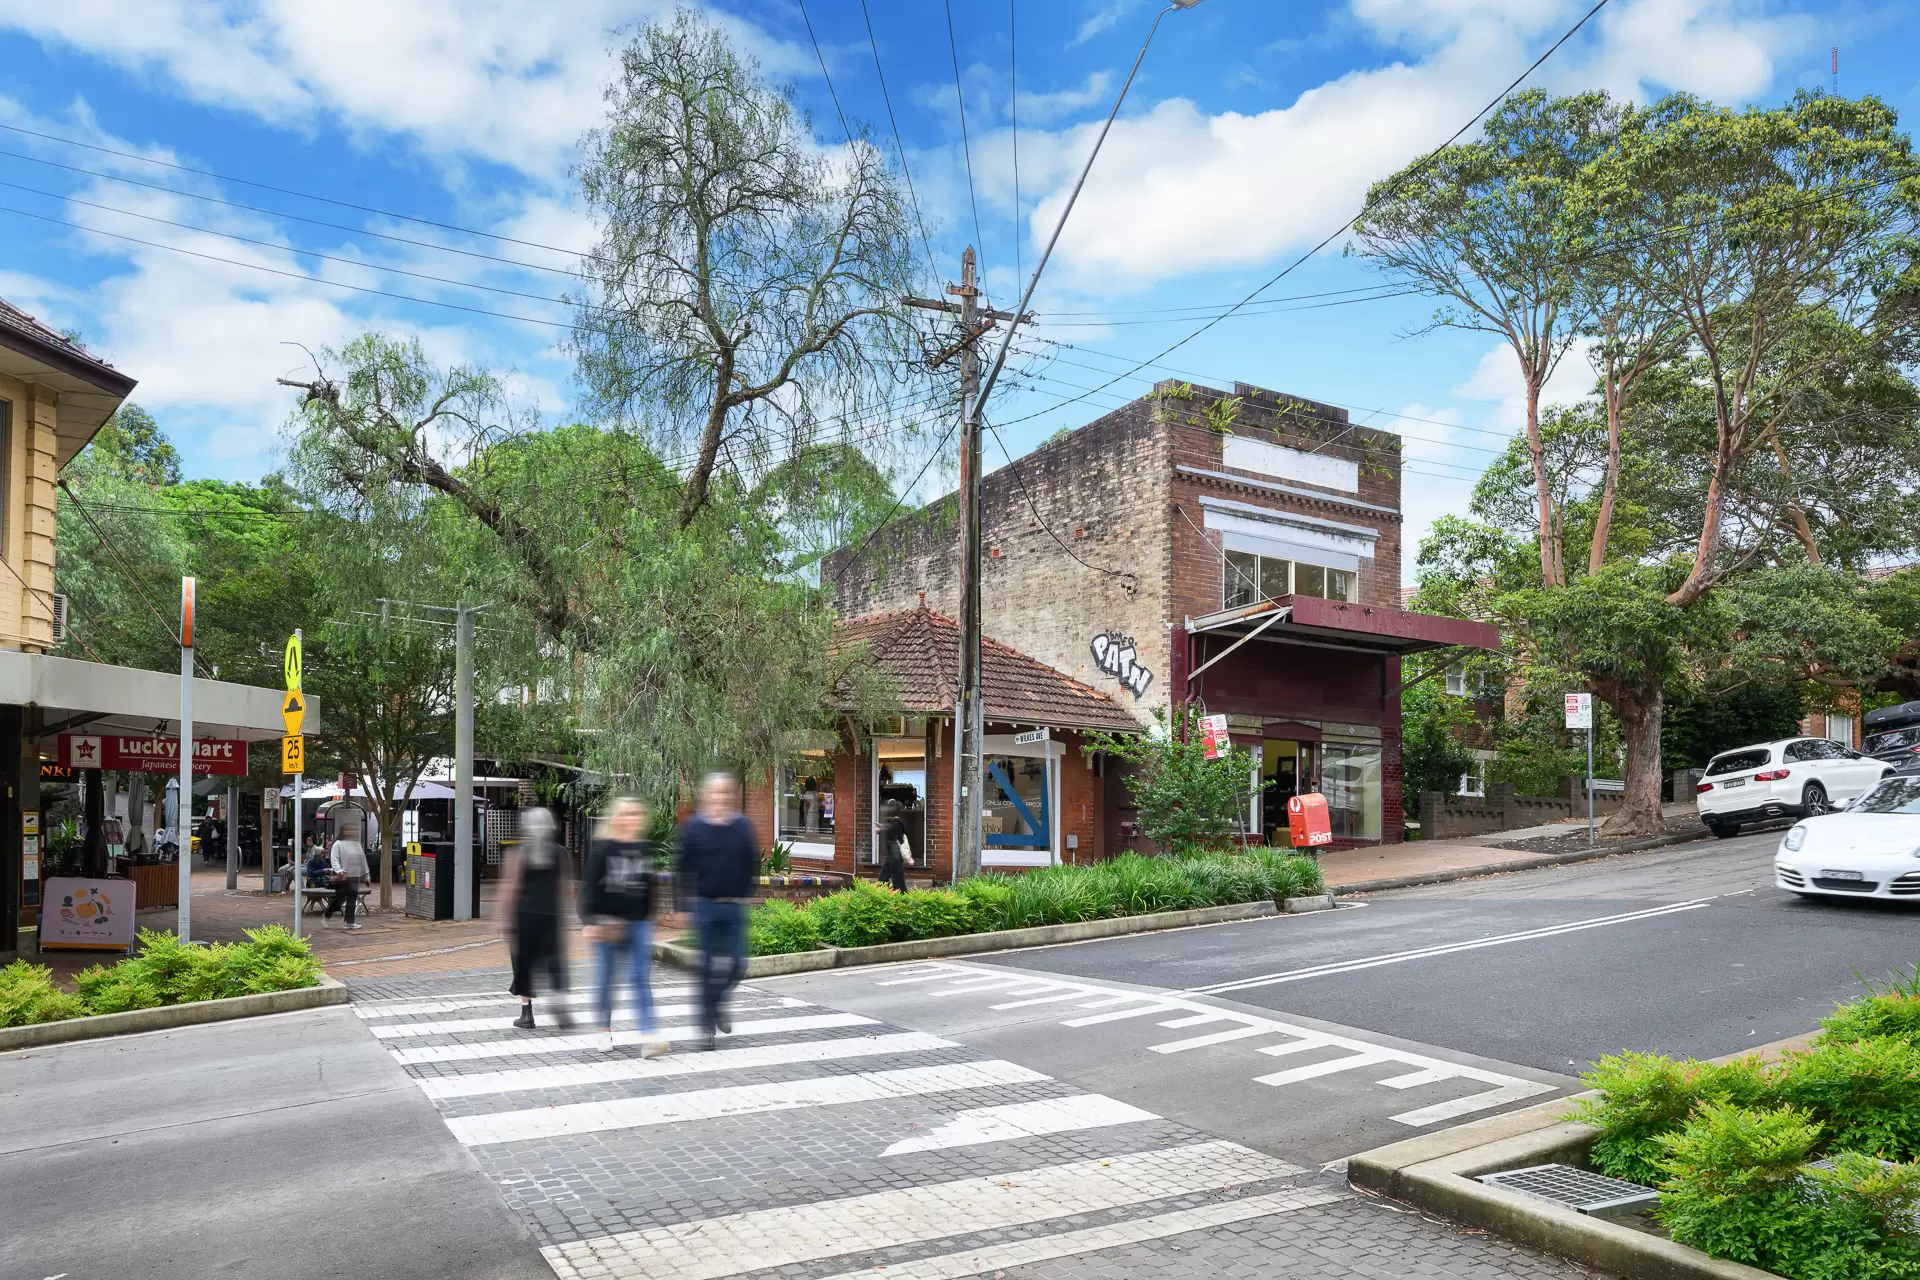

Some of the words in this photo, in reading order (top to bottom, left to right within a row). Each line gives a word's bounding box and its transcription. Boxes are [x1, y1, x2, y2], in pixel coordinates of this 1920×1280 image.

[1020, 733, 1034, 742] WILKES
[119, 738, 177, 757] Lucky
[288, 740, 299, 759] 25
[141, 760, 176, 770] Japanese
[1310, 832, 1331, 844] POST
